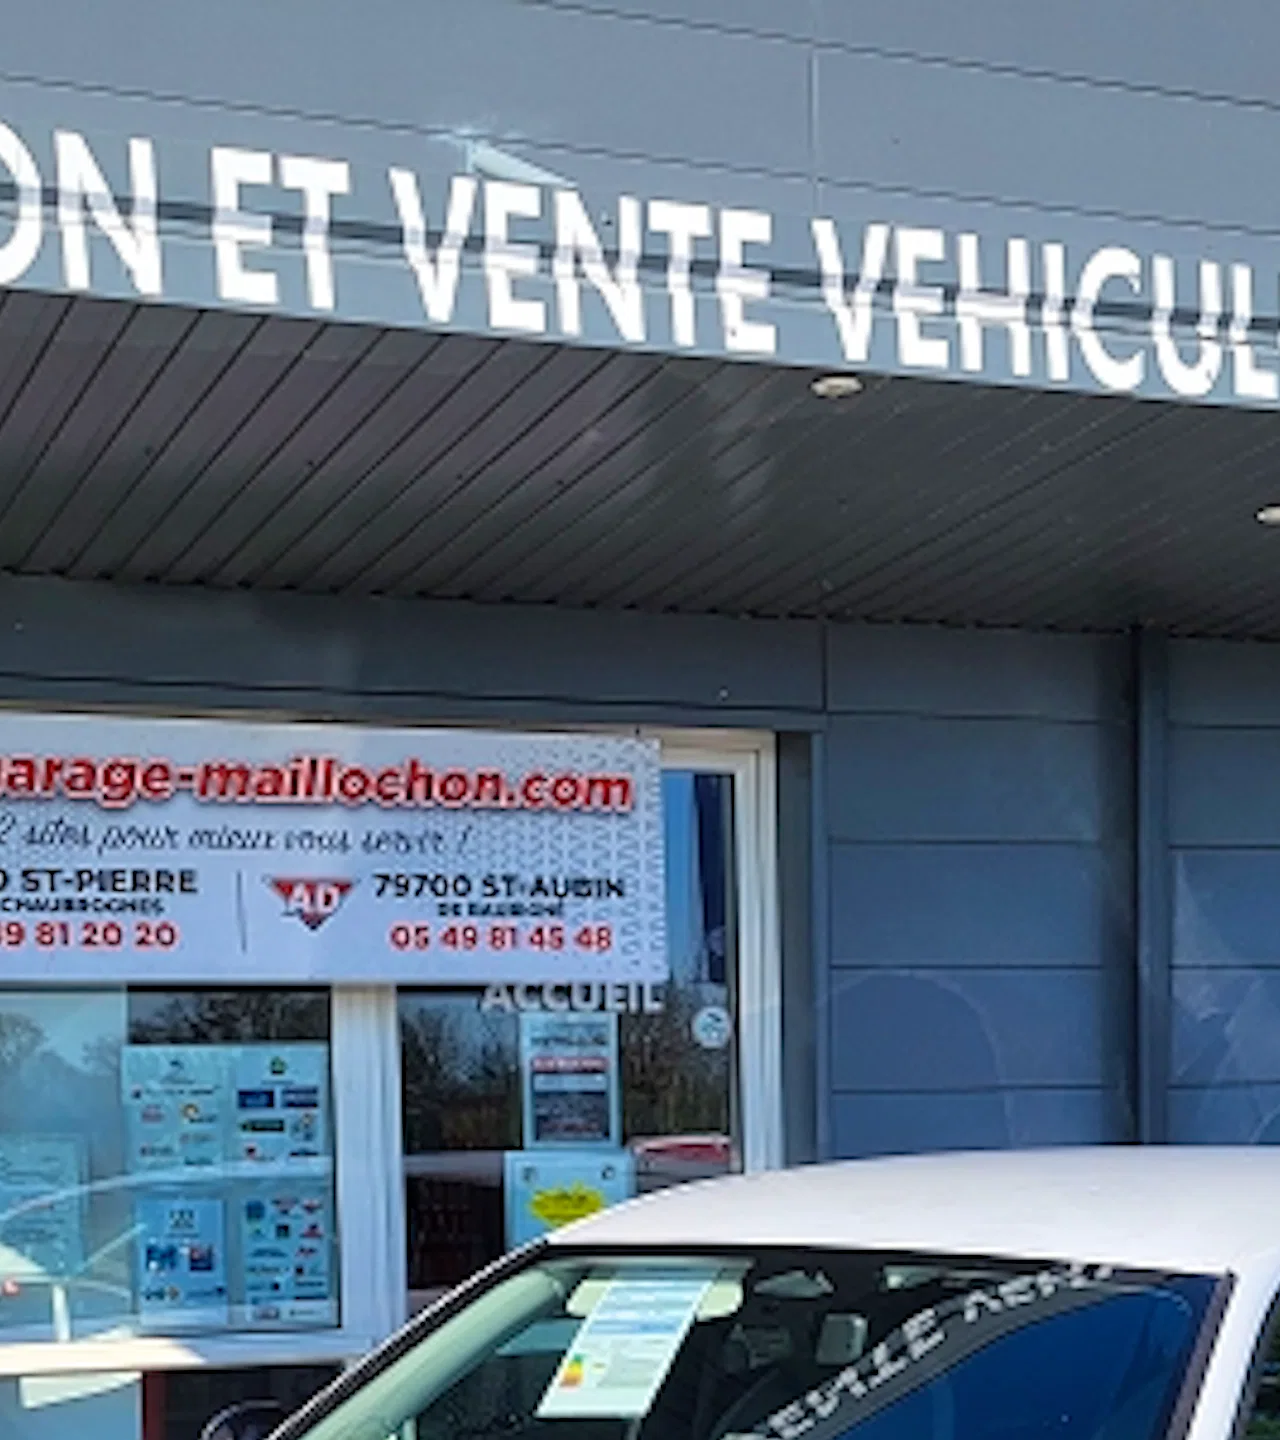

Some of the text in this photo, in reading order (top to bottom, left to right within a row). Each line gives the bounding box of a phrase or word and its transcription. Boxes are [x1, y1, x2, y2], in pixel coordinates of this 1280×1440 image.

[210, 145, 351, 311] ET
[389, 167, 779, 354] VENTE
[21, 868, 199, 894] ST-PIERRE
[374, 873, 472, 899] 79700
[35, 921, 71, 947] 81
[81, 921, 122, 947] 20
[134, 921, 178, 947] 20
[389, 924, 613, 952] 05 49 81 45 48
[478, 982, 665, 1015] ACCUEIL
